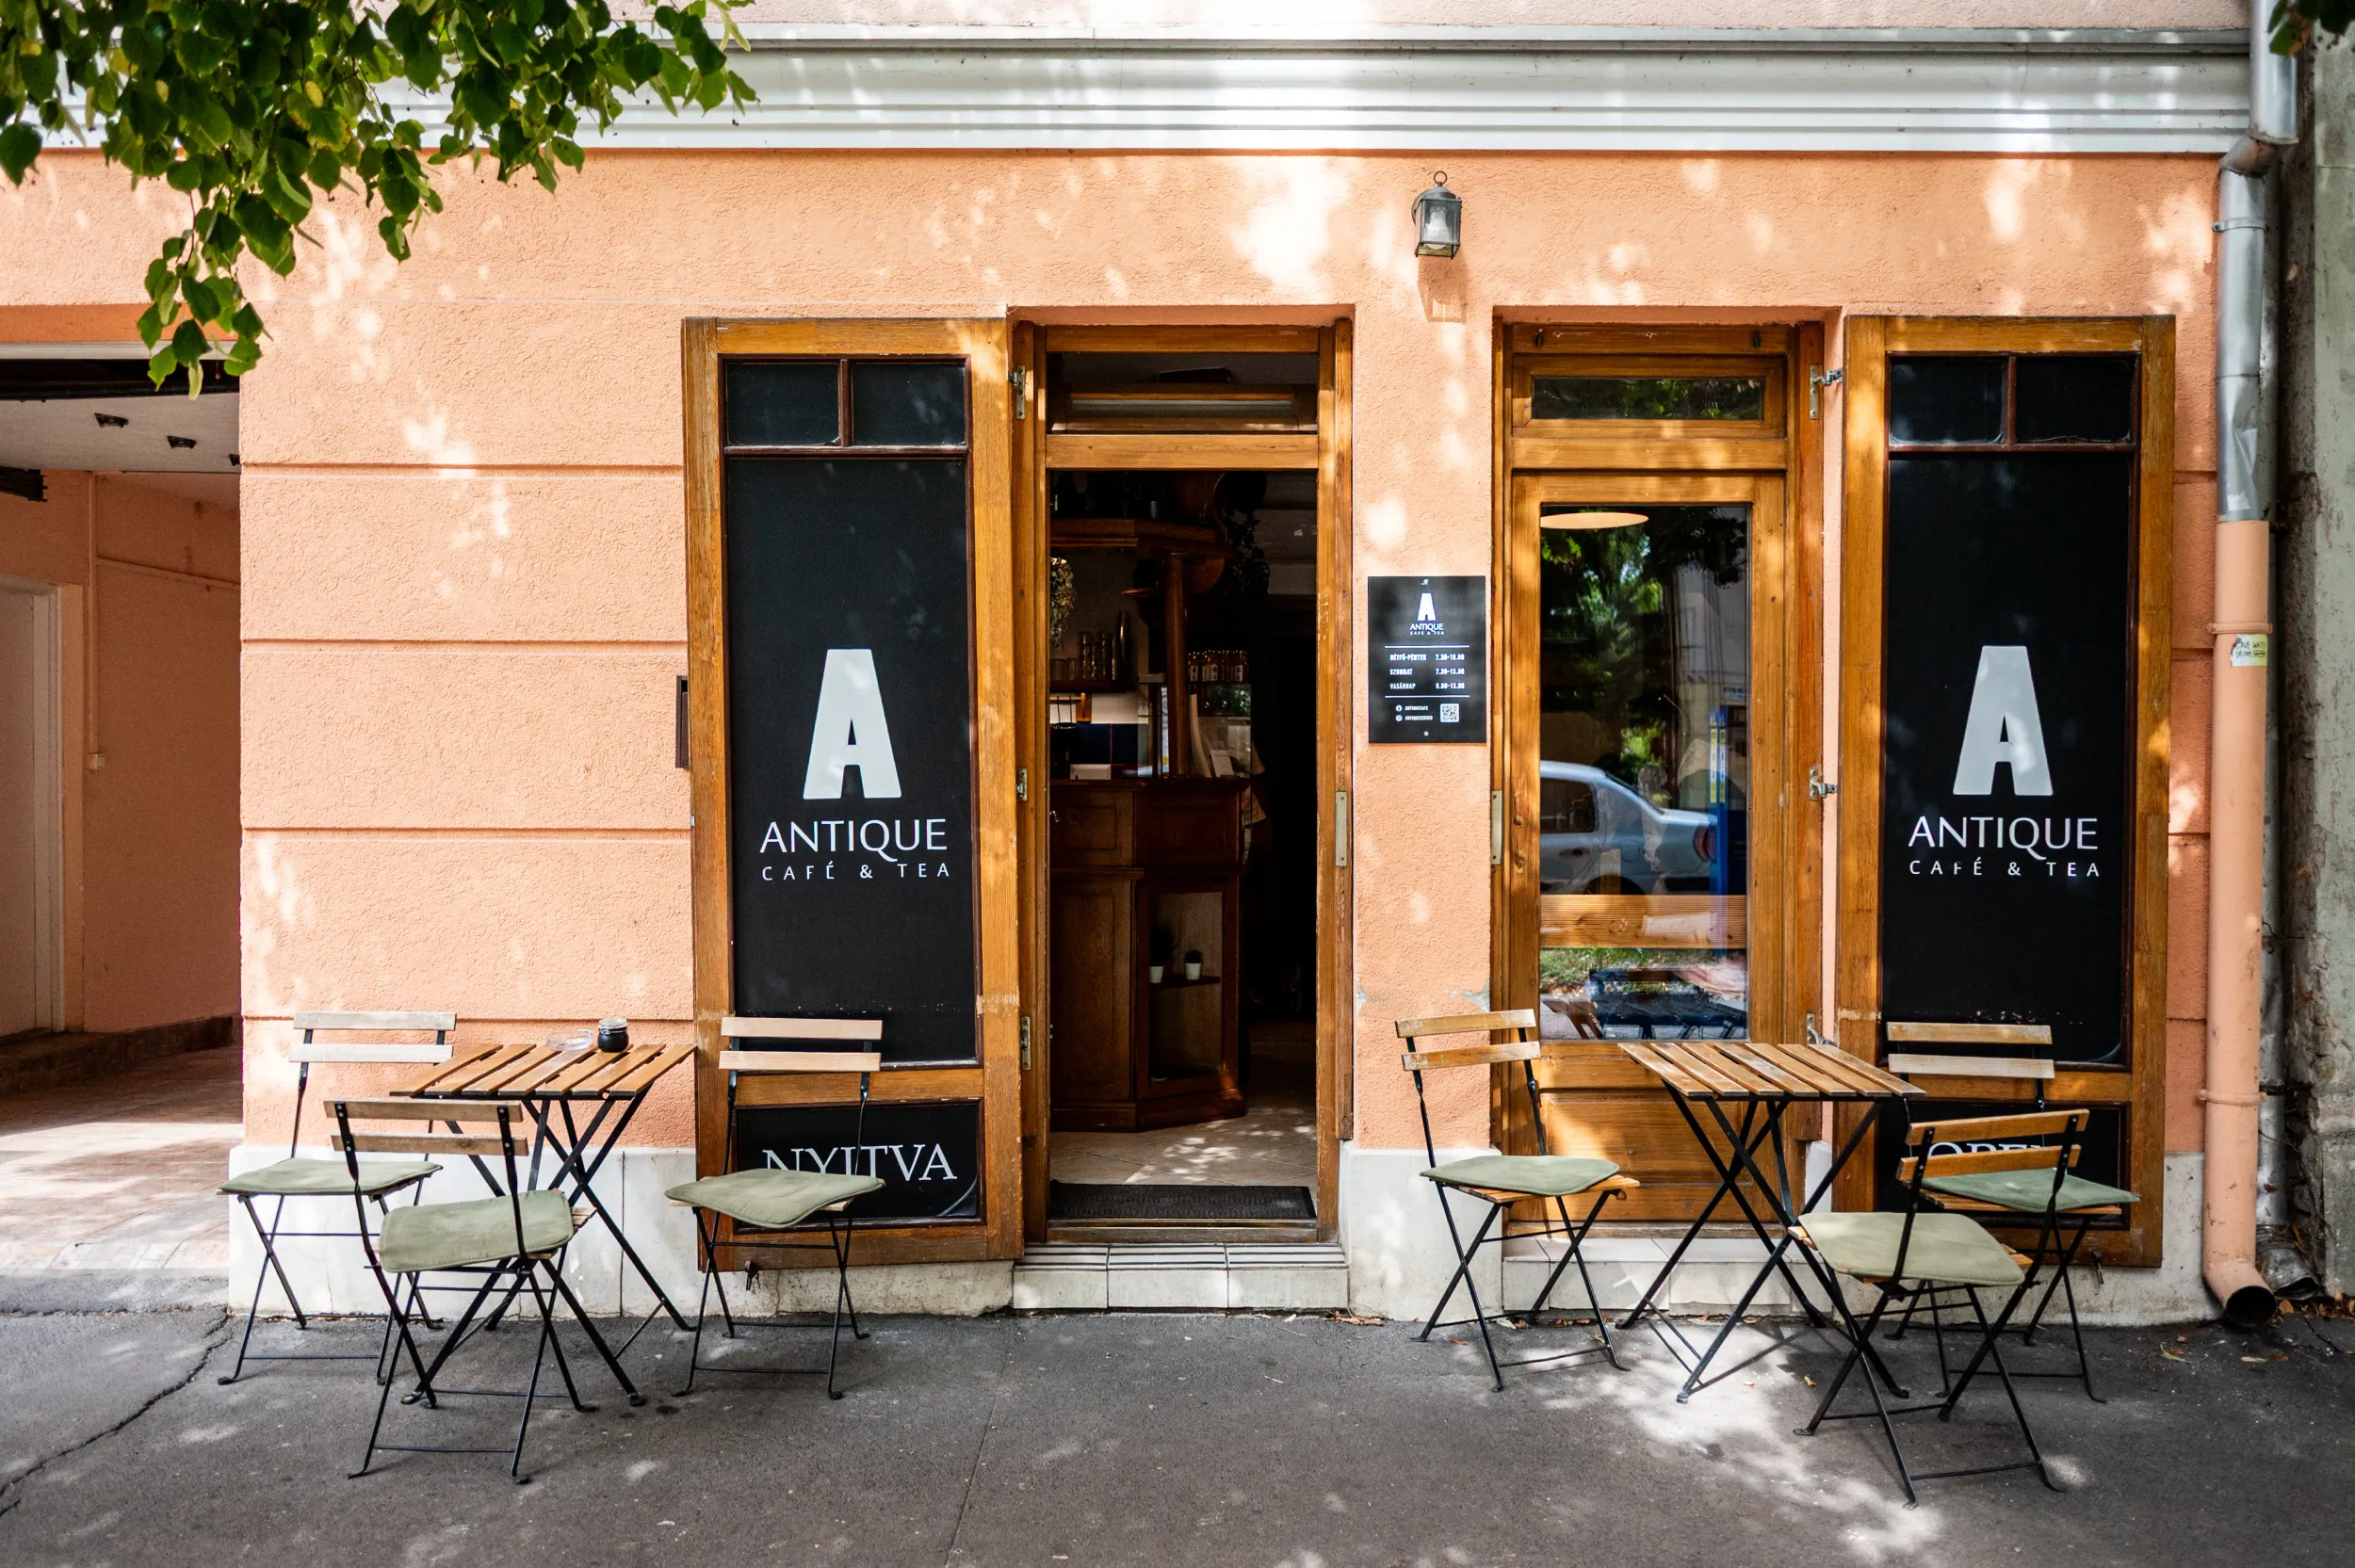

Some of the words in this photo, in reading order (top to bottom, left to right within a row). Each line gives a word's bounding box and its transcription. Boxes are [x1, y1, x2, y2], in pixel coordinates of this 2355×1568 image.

[1417, 592, 1437, 622] A
[1409, 622, 1444, 633] ANTIQUE
[804, 648, 901, 800] A
[1953, 645, 2054, 797] A
[760, 818, 948, 863] ANTIQUE
[1908, 816, 2098, 860] ANTIQUE
[762, 861, 835, 881] CAFÉ
[859, 864, 873, 879] &
[897, 862, 950, 879] TEA
[1909, 857, 1983, 876] CAFÉ
[2007, 861, 2022, 876] &
[2045, 861, 2100, 877] TEA
[762, 1143, 958, 1182] NYITVA
